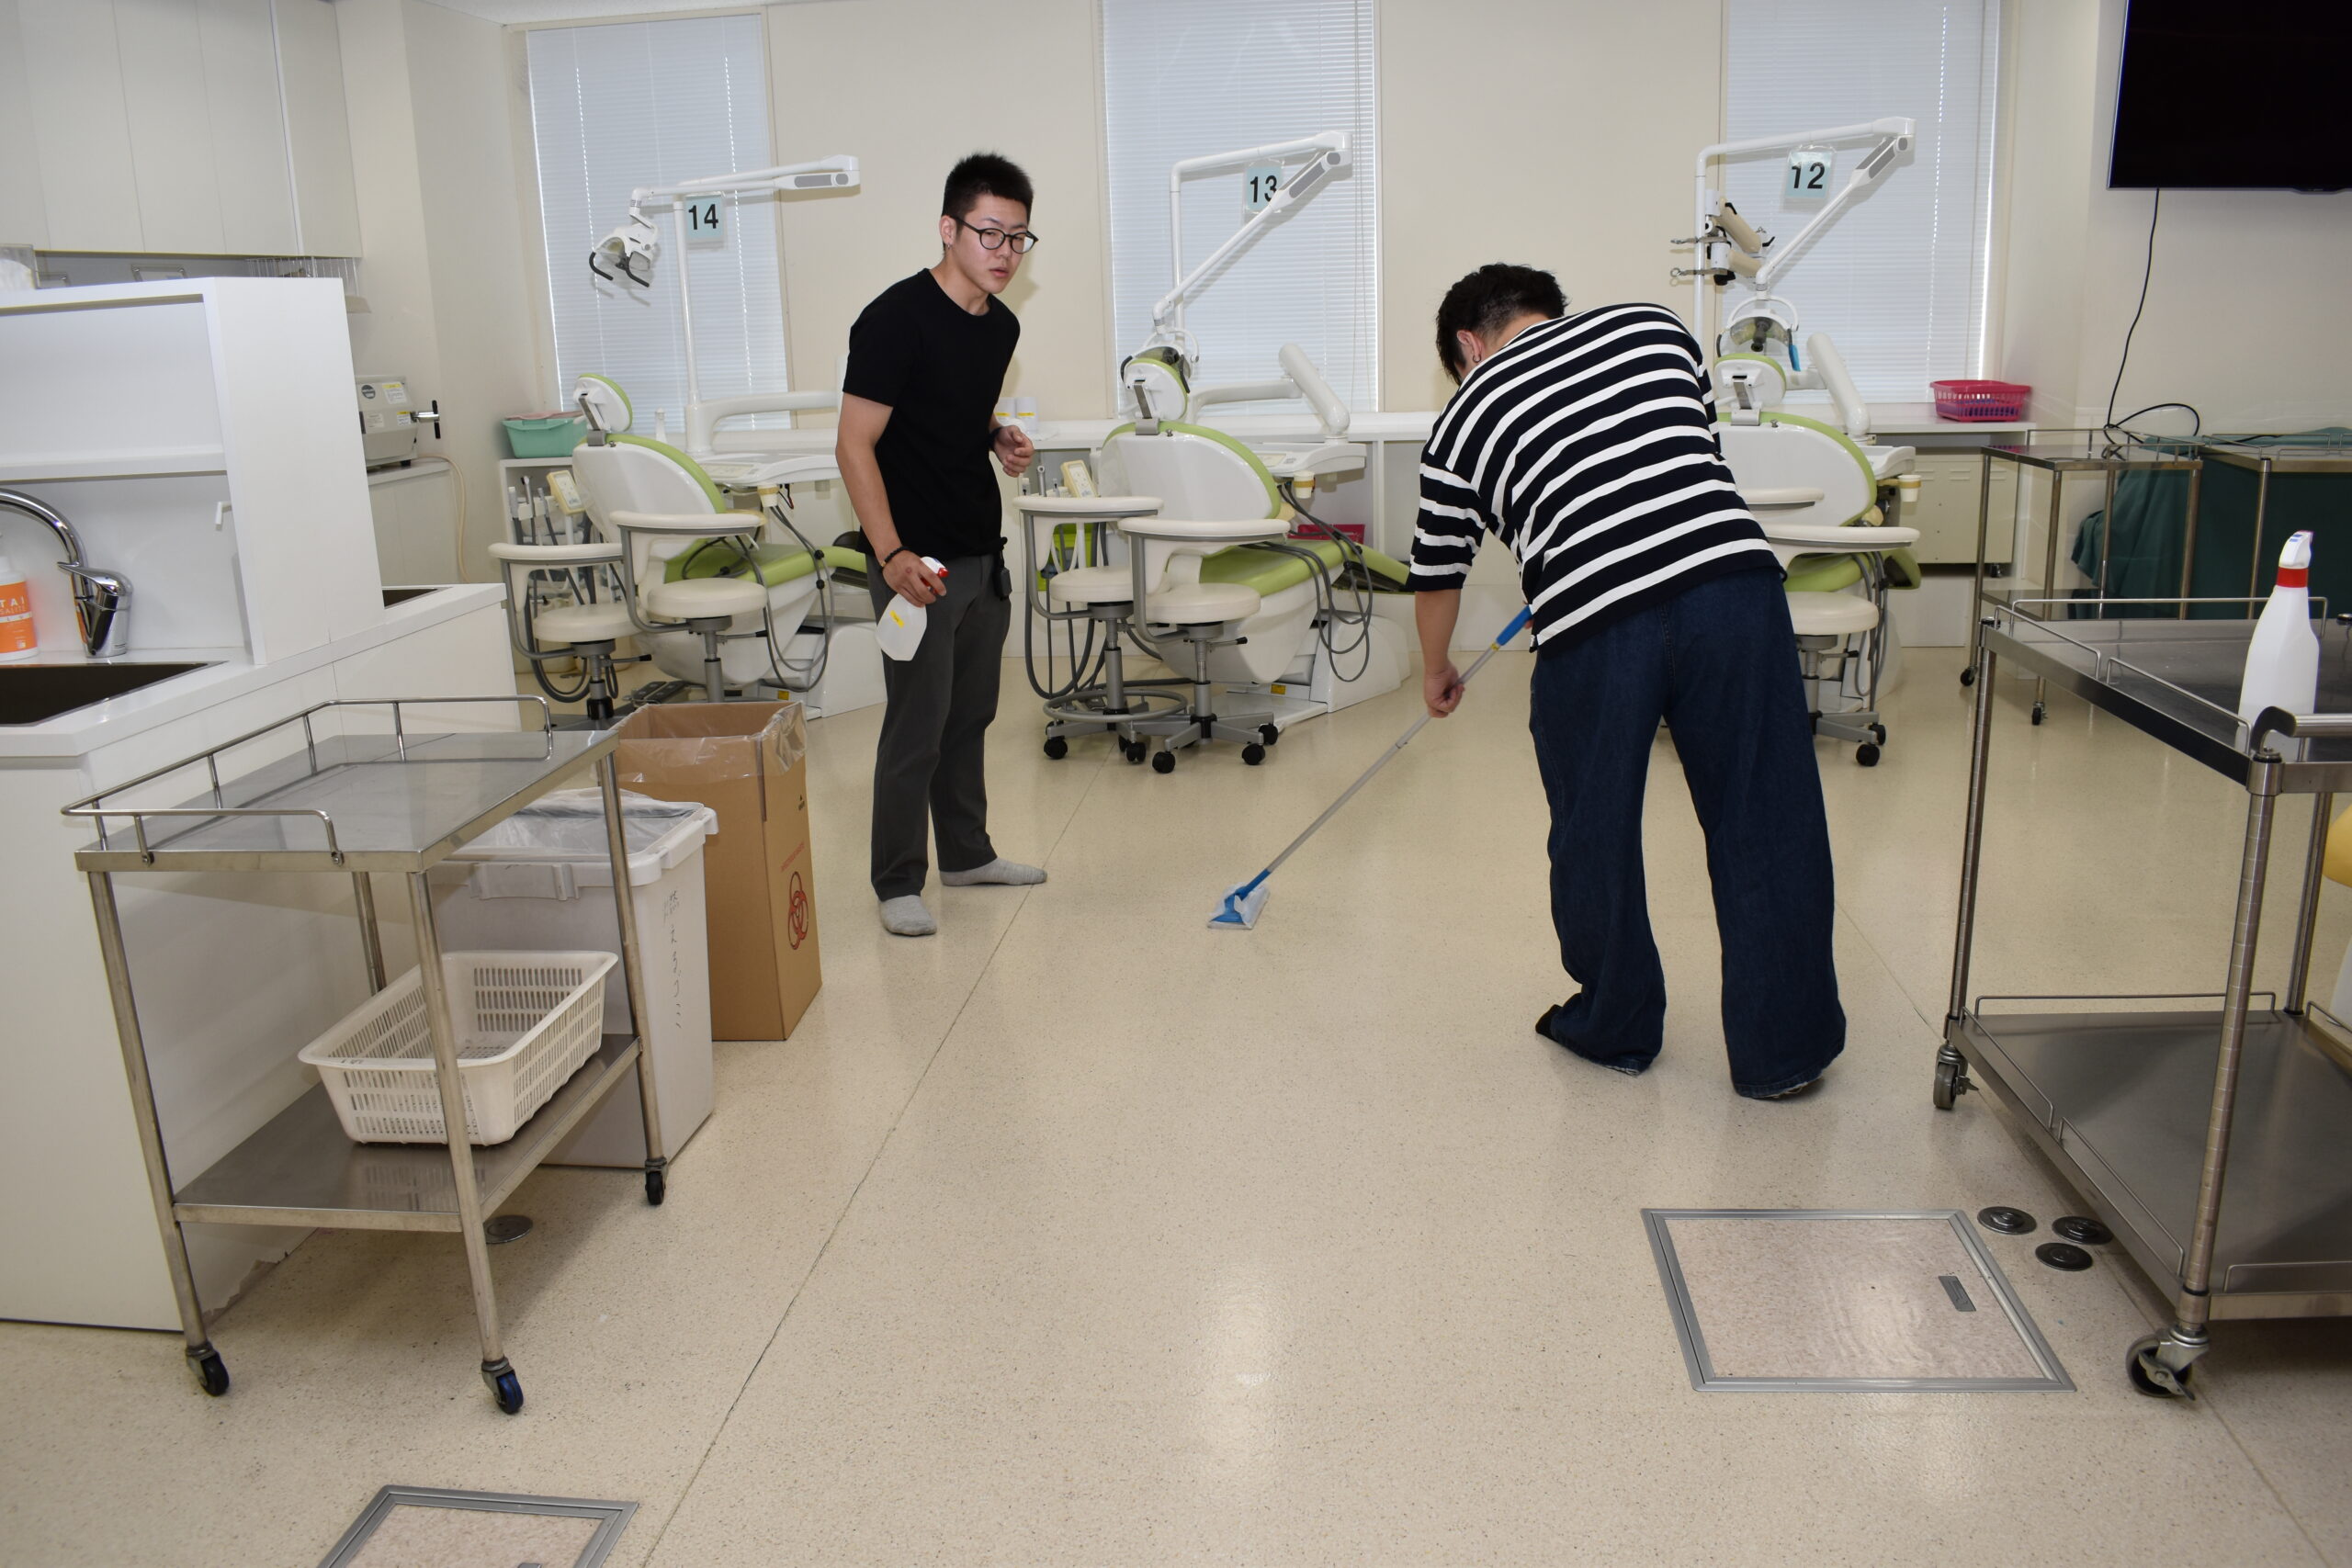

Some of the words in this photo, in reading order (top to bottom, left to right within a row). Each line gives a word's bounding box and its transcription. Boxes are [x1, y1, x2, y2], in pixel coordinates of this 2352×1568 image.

[1250, 175, 1277, 203] 13
[1792, 162, 1826, 189] 12
[688, 203, 719, 231] 14
